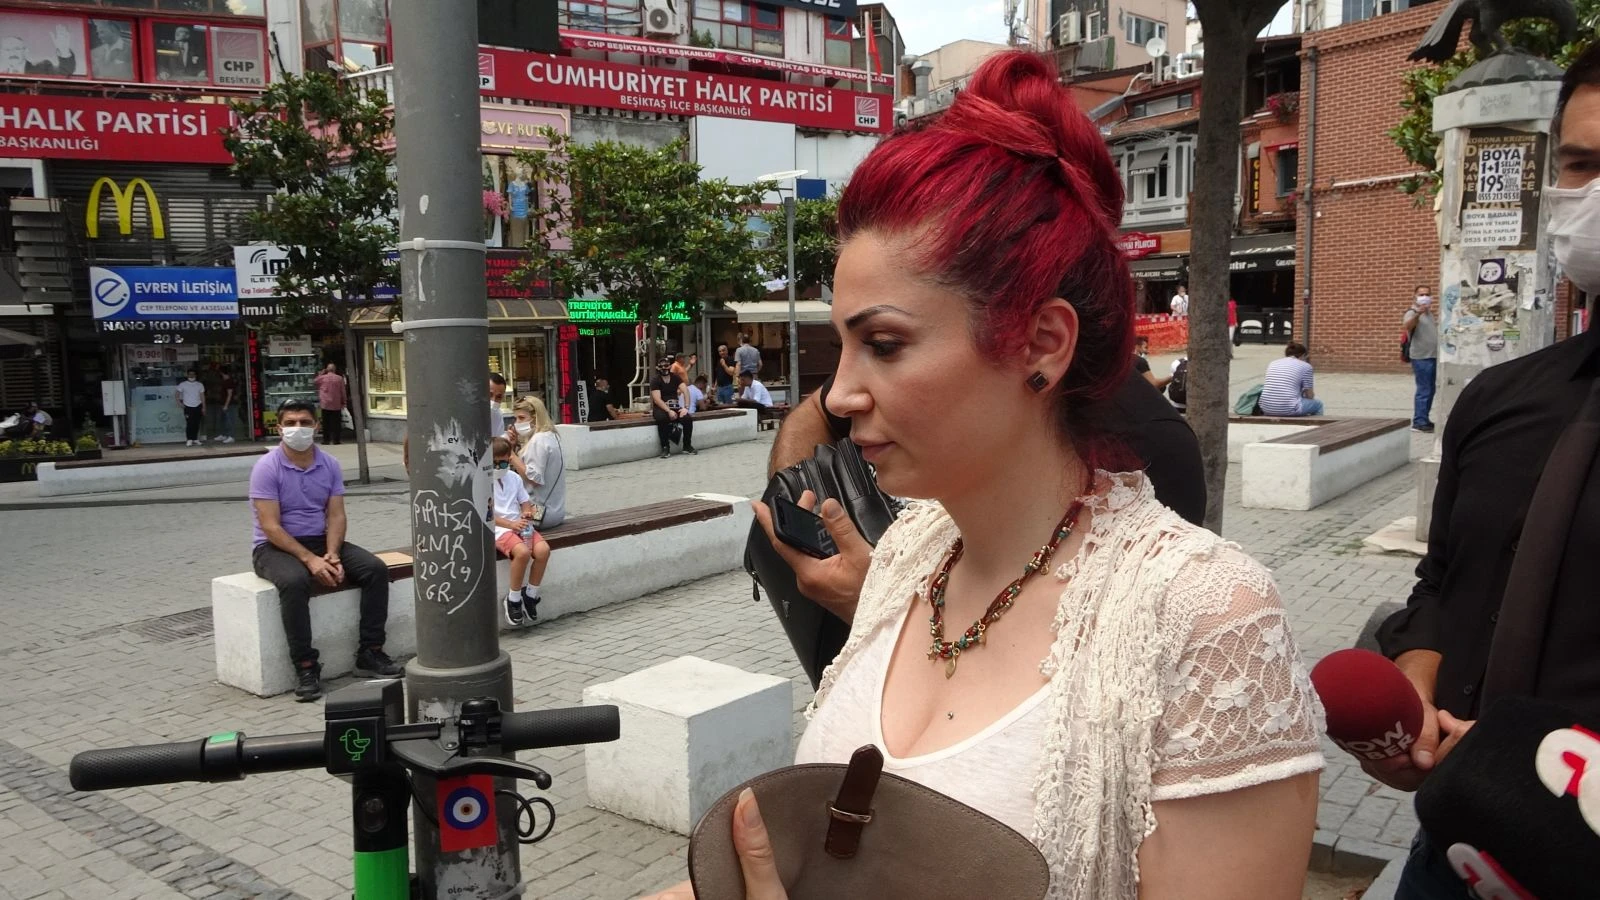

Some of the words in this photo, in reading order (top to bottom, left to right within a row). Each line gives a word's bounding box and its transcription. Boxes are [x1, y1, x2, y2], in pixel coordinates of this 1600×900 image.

[587, 40, 605, 48] CHP
[223, 60, 255, 72] CHP
[741, 56, 762, 64] CHP
[763, 58, 810, 73] BEŞİKTAŞ
[811, 66, 833, 76] İLÇE
[526, 61, 687, 98] CUMHURİYET
[695, 80, 752, 105] HALK
[759, 87, 833, 113] PARTİSİ
[620, 94, 667, 110] BEŞİKTAŞ
[669, 98, 691, 111] İLÇE
[693, 101, 751, 117] BAŞKANLIĞI
[0, 106, 86, 132] HALK
[96, 107, 208, 136] PARTİSİ
[857, 116, 876, 125] CHP
[0, 136, 99, 151] BAŞKANLIĞI
[1481, 149, 1521, 161] BOYA
[1481, 161, 1500, 174] 1+1
[1480, 175, 1504, 192] 195
[134, 282, 178, 294] EVREN
[182, 280, 233, 296] İLETİŞİM
[103, 320, 146, 331] NANO
[149, 320, 231, 331] KORUYUCU
[153, 334, 171, 344] 20
